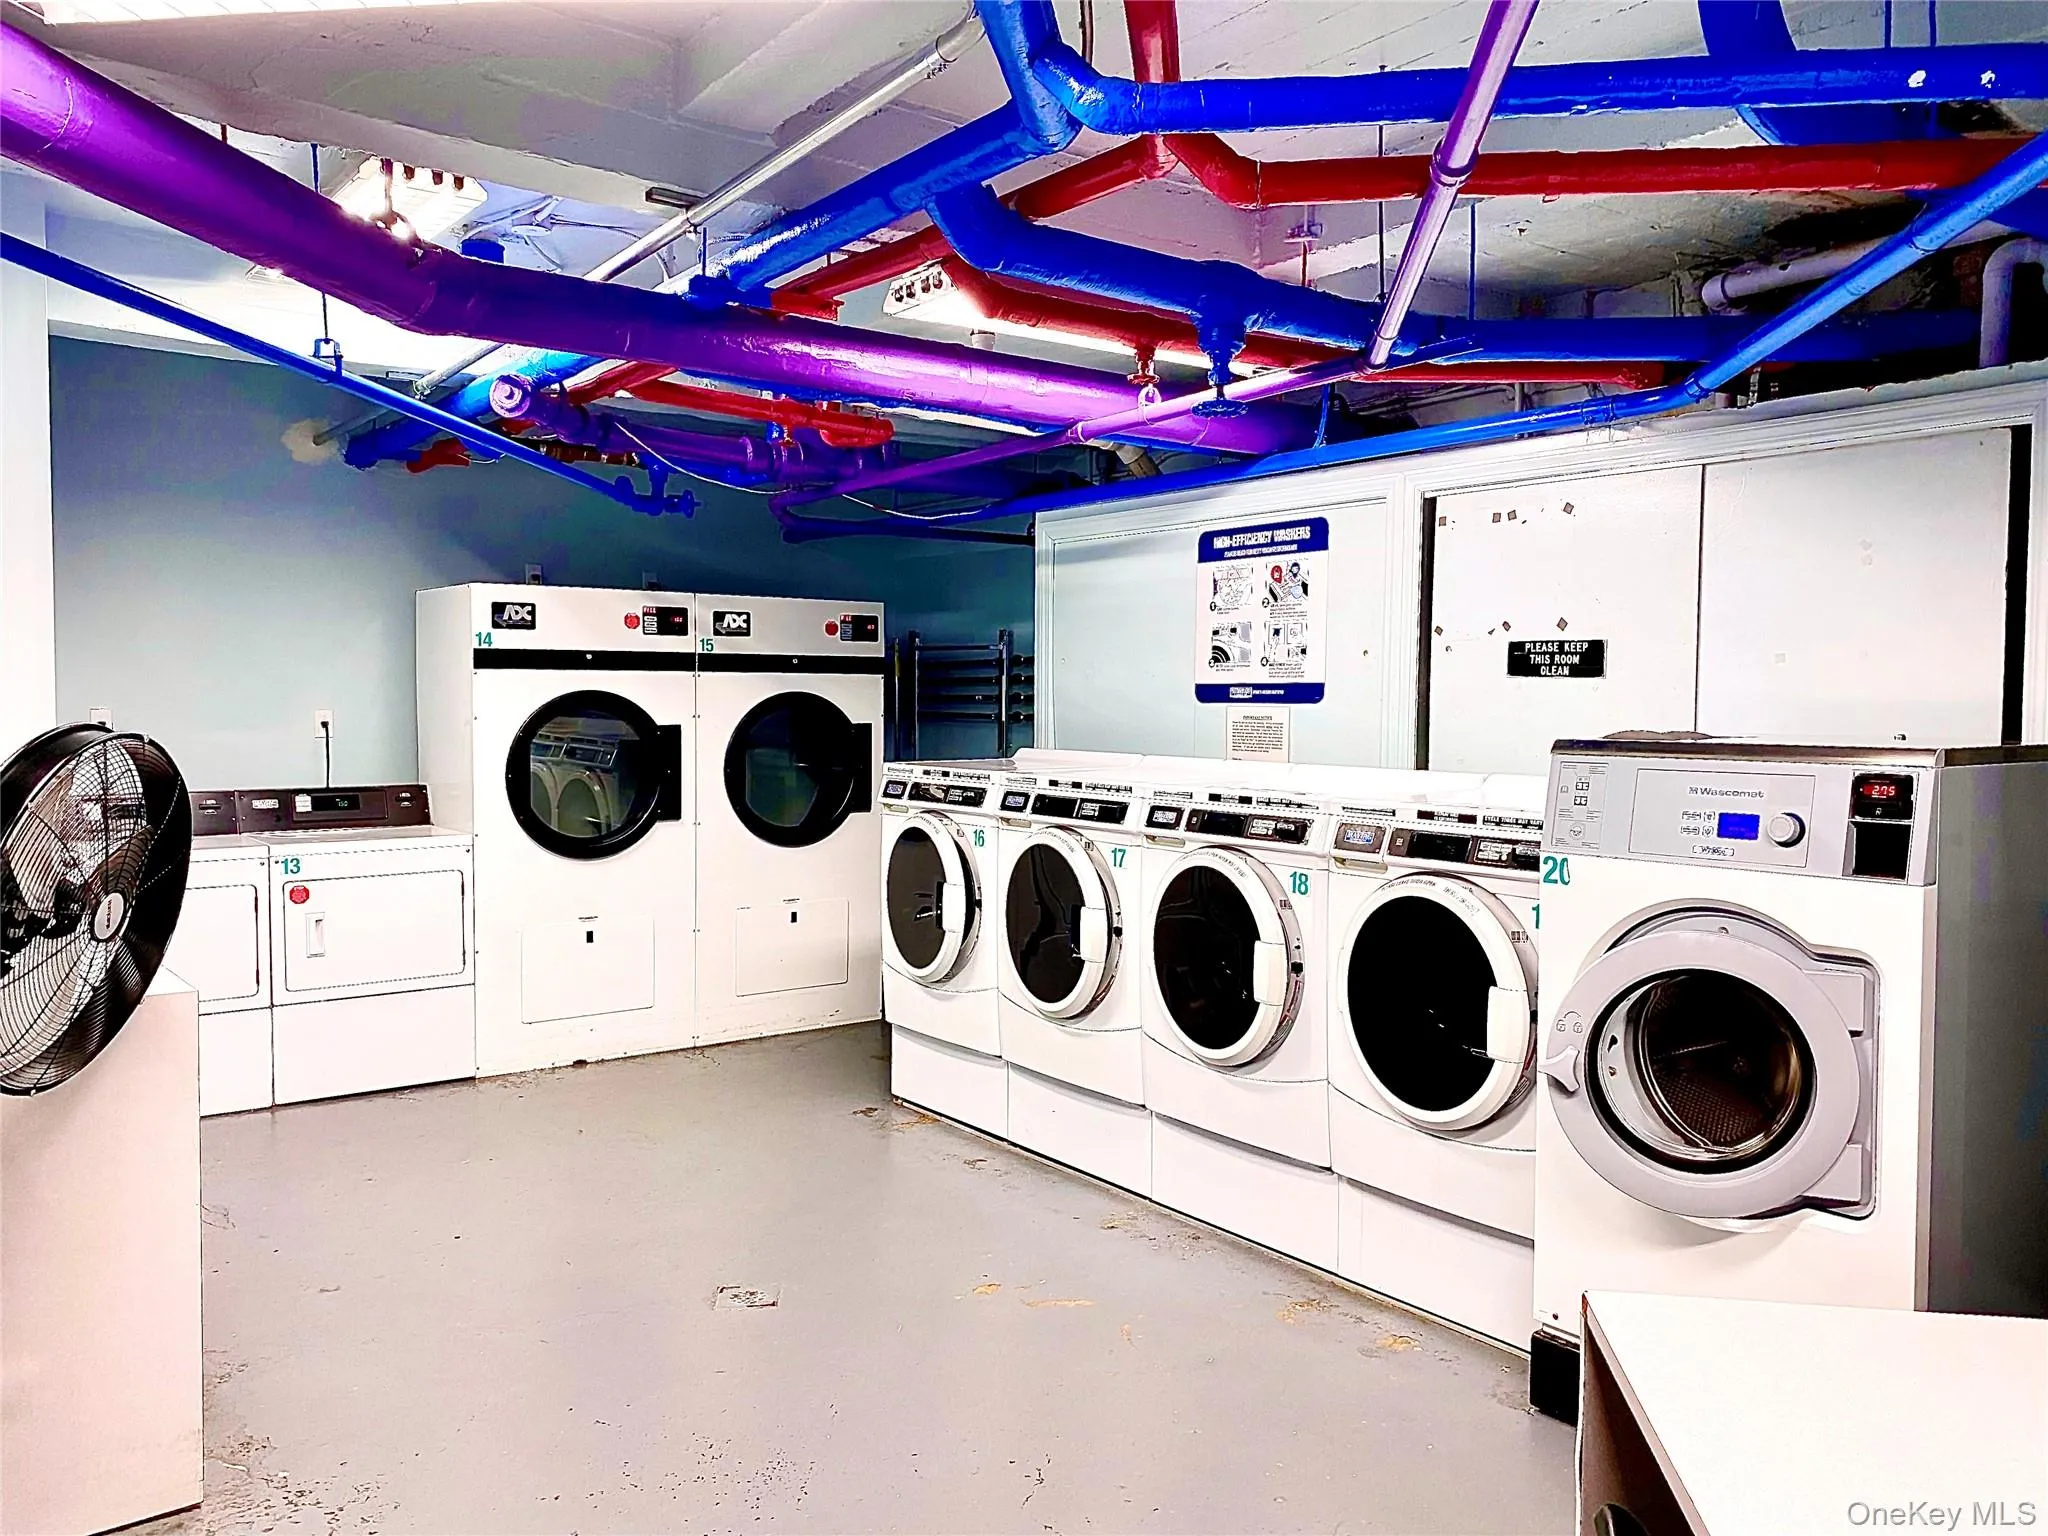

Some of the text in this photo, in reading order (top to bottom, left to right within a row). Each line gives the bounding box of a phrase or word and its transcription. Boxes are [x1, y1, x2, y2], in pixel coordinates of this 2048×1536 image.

[1213, 526, 1311, 549] HIGH-EFFICIENCY WASHERS
[475, 631, 493, 647] 14
[699, 638, 714, 652] 15
[1525, 642, 1589, 653] PLEASE KEEP
[1529, 654, 1580, 665] THIS ROOM
[1540, 665, 1570, 676] CLEAN
[1699, 787, 1765, 798] Wascomat
[973, 828, 985, 847] 16
[281, 857, 301, 875] 13
[1111, 847, 1126, 868] 17
[1542, 855, 1571, 886] 20
[1289, 871, 1309, 896] 18
[1531, 903, 1540, 929] 1
